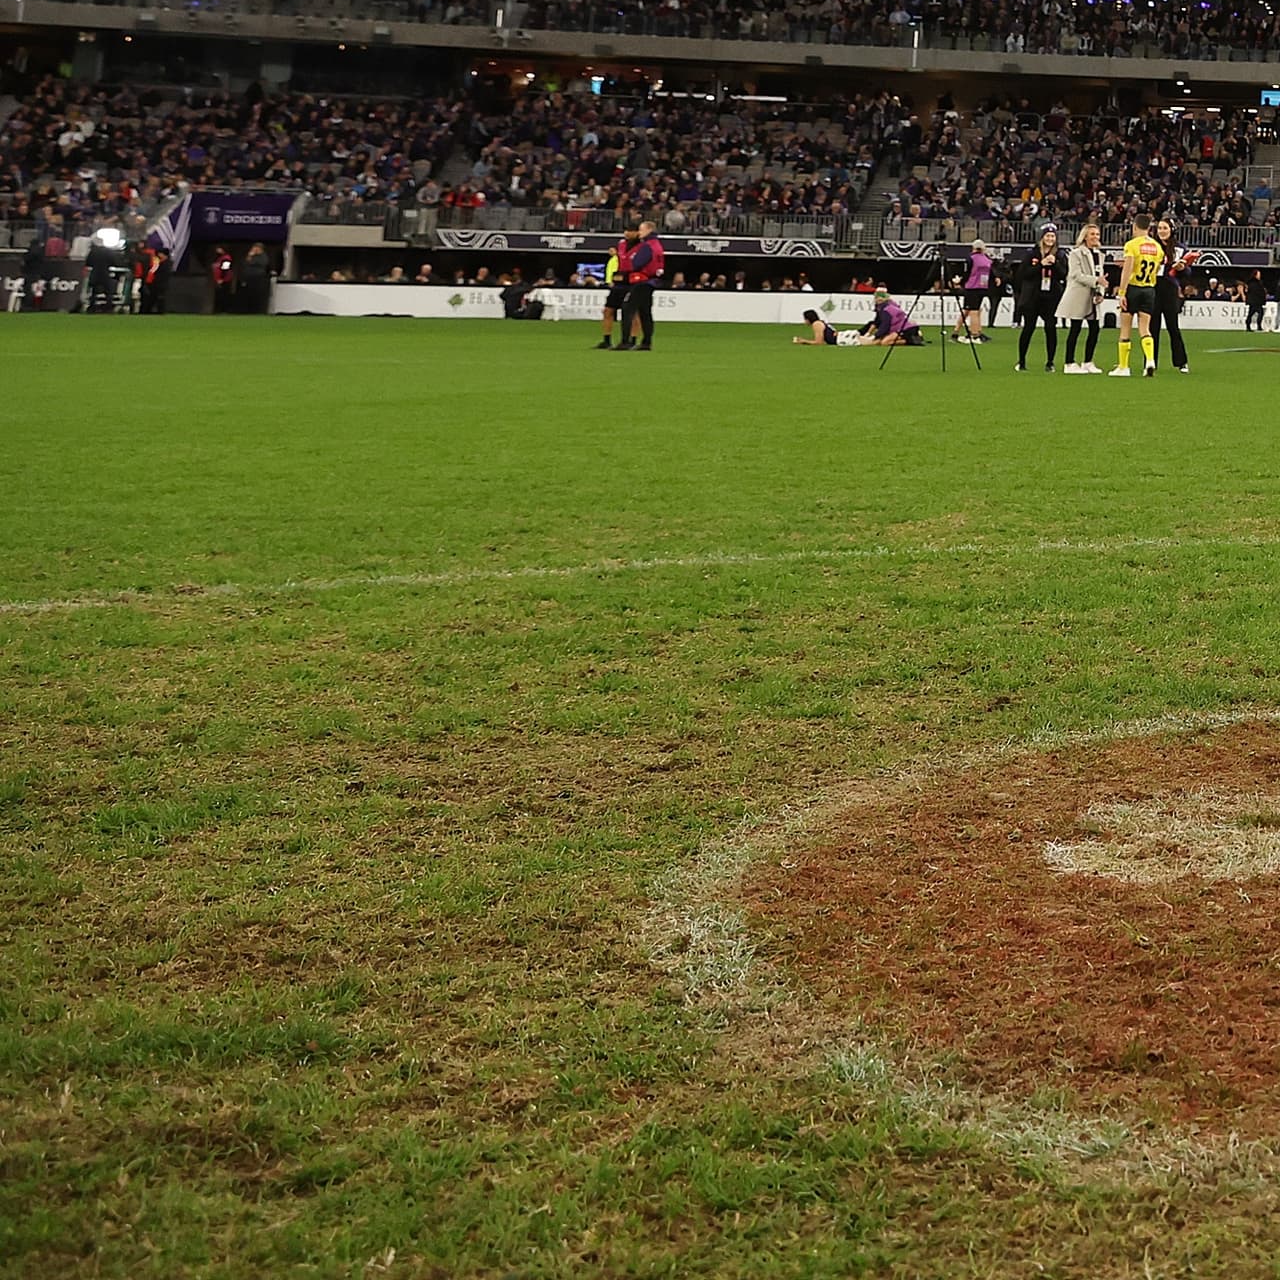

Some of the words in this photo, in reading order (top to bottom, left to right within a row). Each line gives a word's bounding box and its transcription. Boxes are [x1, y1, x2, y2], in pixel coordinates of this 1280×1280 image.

[1136, 260, 1155, 283] 32
[51, 278, 80, 292] for
[469, 292, 497, 304] HA
[1183, 305, 1215, 317] HAY
